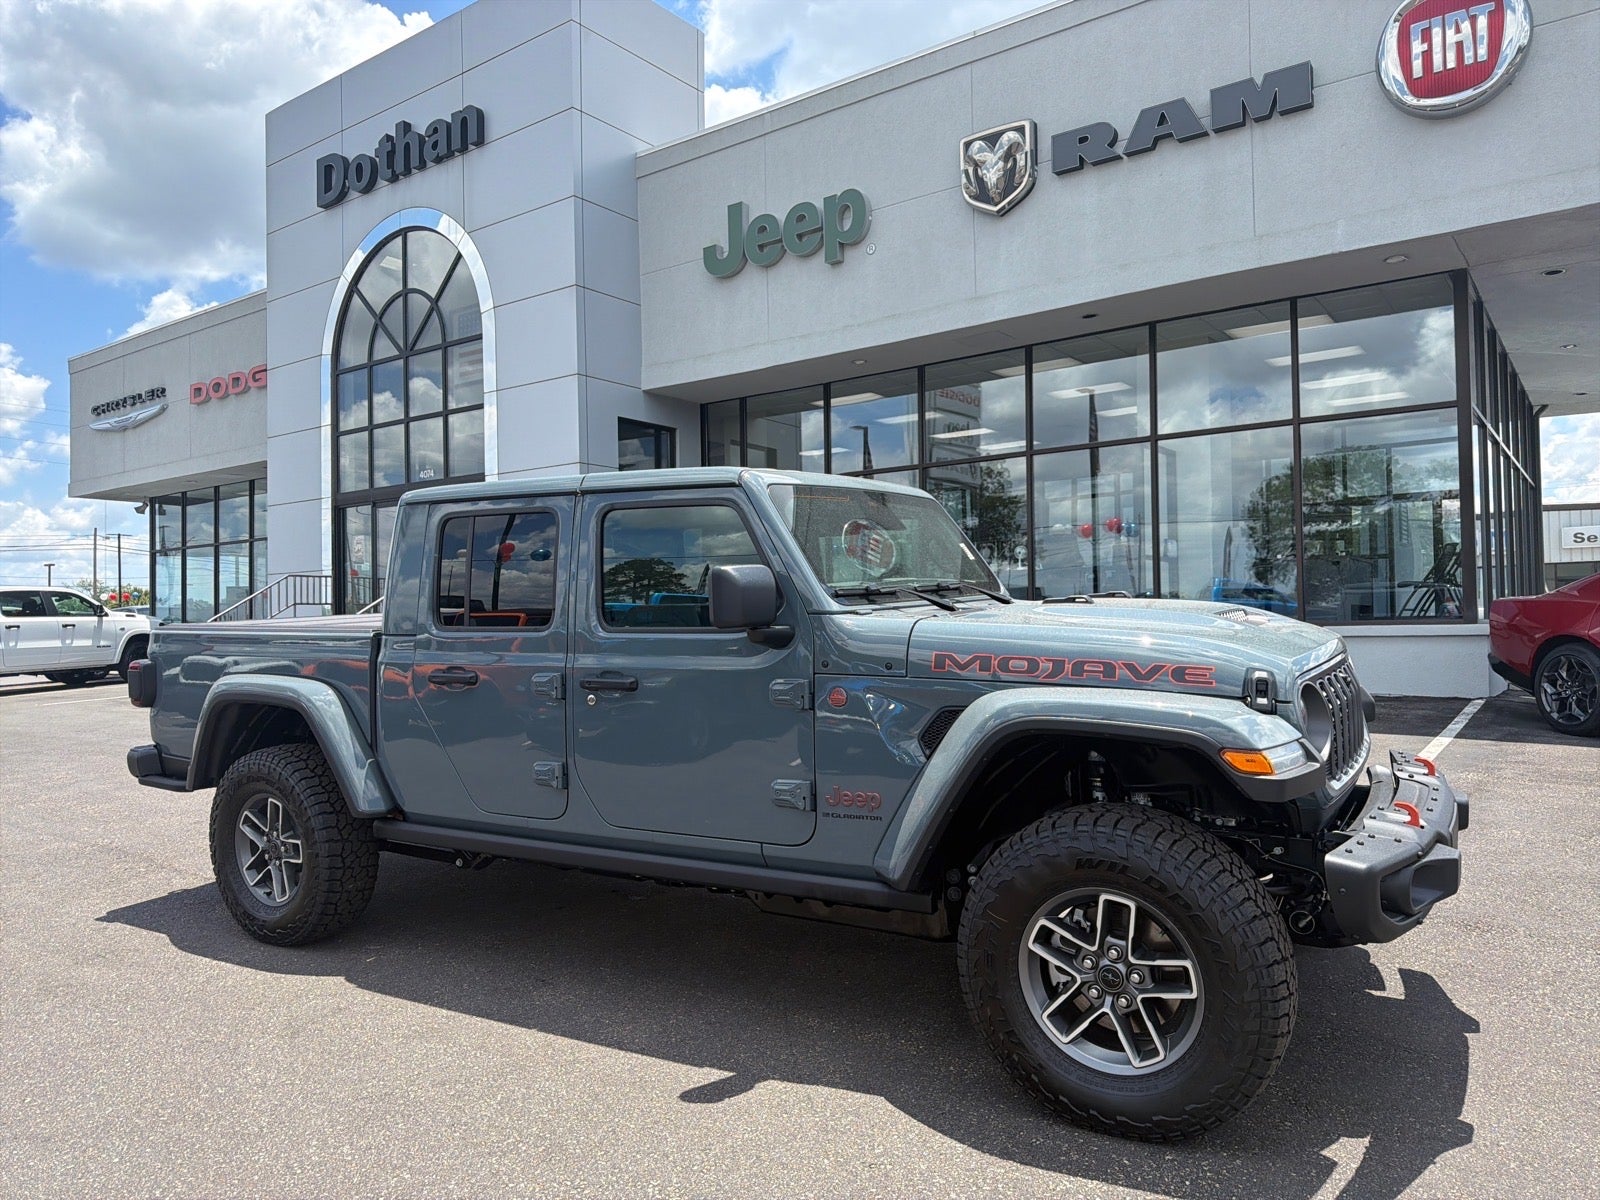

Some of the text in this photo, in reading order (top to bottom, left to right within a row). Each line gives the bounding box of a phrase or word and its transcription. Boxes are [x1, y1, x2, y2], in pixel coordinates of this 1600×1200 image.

[1410, 2, 1495, 79] FIAT
[1051, 60, 1314, 176] RAM
[316, 104, 485, 209] Dothan
[703, 188, 872, 278] Jeep
[91, 386, 167, 416] CHRYSLER
[419, 468, 434, 479] 4074
[1573, 532, 1599, 544] Se
[932, 651, 1216, 687] MOJAVE
[825, 785, 882, 813] Jeep
[831, 812, 883, 822] GLADIATOR
